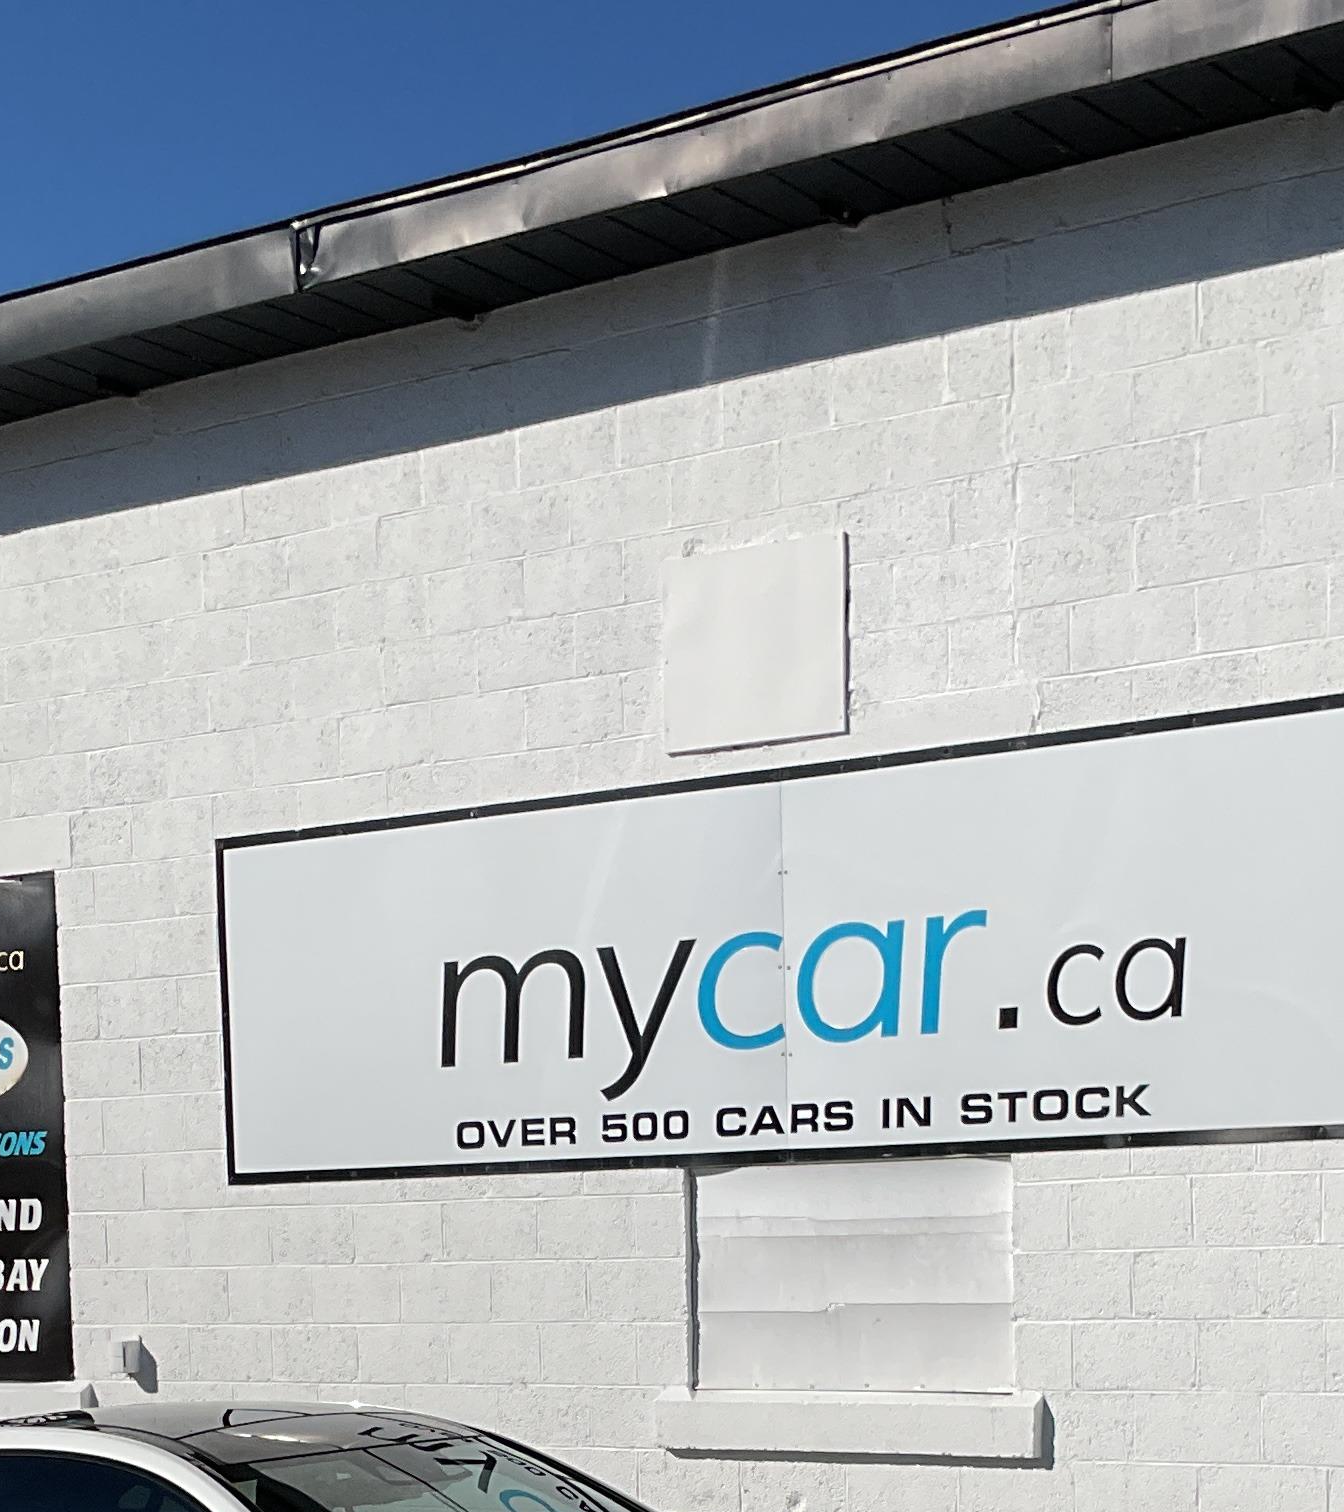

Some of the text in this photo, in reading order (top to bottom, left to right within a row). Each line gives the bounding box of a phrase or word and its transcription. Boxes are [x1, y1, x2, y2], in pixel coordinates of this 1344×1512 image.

[440, 908, 1188, 1102] mycar.ca
[456, 1083, 1152, 1150] OVER 500 CARS IN STOCK
